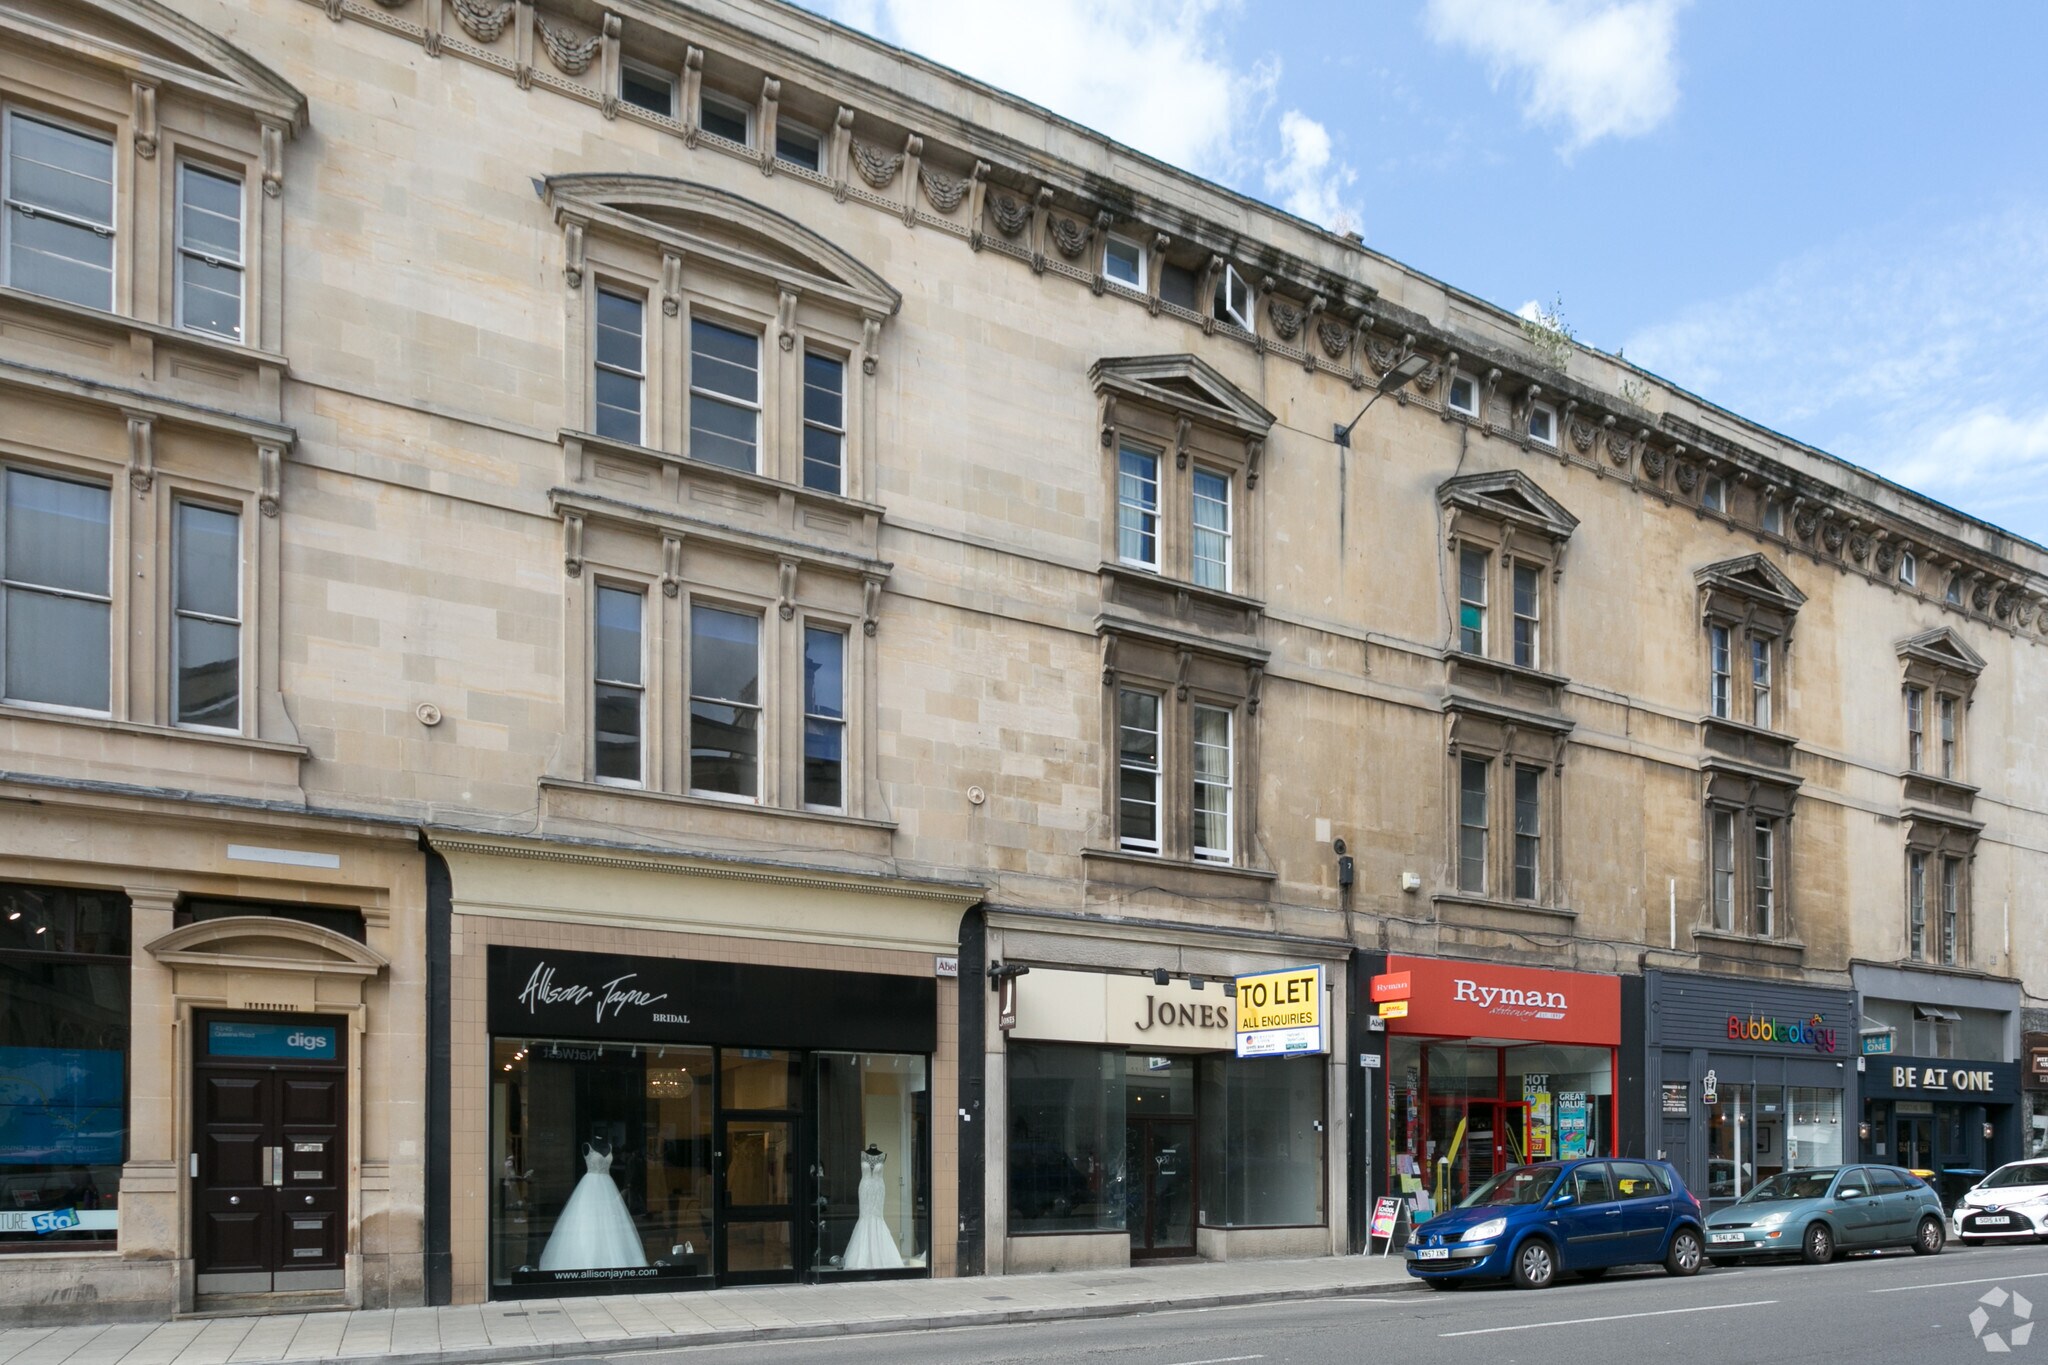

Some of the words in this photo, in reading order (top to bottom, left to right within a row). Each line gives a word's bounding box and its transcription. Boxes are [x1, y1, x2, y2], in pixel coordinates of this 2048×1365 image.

[938, 962, 957, 972] Abel
[518, 961, 593, 1015] Allison
[595, 973, 668, 1024] Jayne
[1240, 983, 1267, 1008] TO
[1274, 977, 1314, 1005] LET
[1376, 982, 1408, 991] Ryman
[1453, 979, 1568, 1009] Ryman
[653, 1013, 690, 1024] BRIDAL
[1135, 995, 1229, 1031] JONES
[1243, 1017, 1259, 1029] ALL
[1261, 1011, 1313, 1027] ENQUIRIES
[287, 1032, 327, 1050] digs
[1727, 1015, 1836, 1053] Bubbleology
[1867, 1043, 1887, 1051] ONE
[1524, 1075, 1549, 1084] HOT
[1893, 1067, 1917, 1088] BE
[1923, 1068, 1948, 1086] AT
[1953, 1070, 1993, 1091] ONE
[1524, 1085, 1549, 1094] DEAL
[555, 1268, 658, 1279] www.allisonjayne.com
